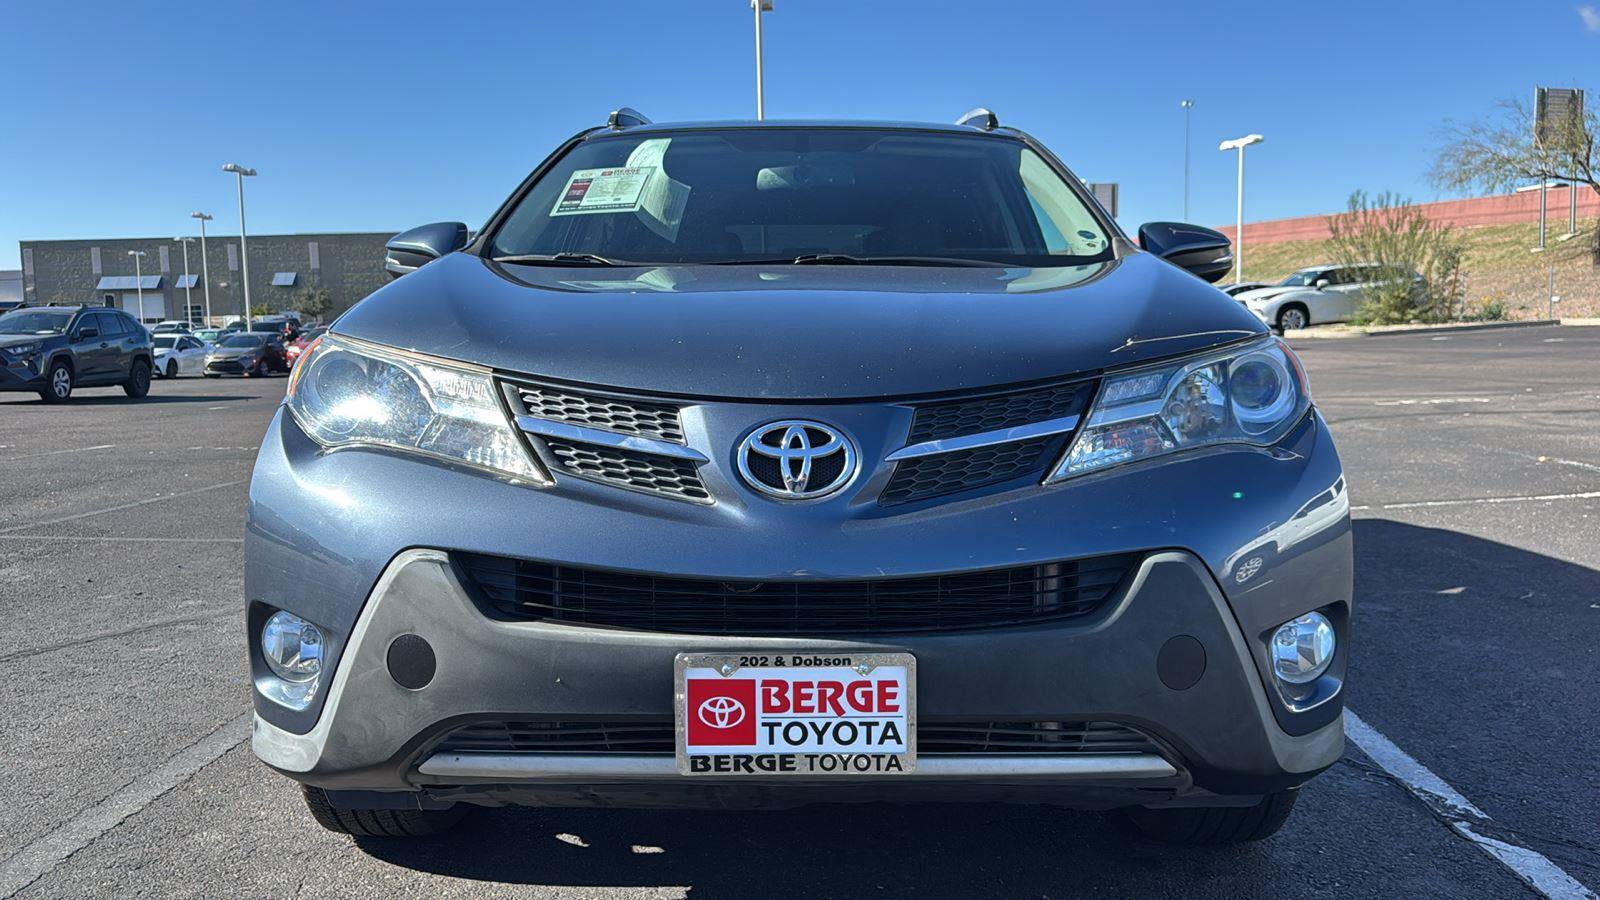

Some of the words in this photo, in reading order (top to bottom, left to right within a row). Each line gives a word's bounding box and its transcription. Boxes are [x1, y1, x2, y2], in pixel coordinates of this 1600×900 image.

[740, 656, 769, 667] 202
[774, 656, 787, 667] &
[792, 656, 852, 667] Dobson
[760, 679, 900, 717] BERGE
[761, 721, 903, 746] TOYOTA
[690, 754, 797, 773] BERGE
[804, 754, 903, 772] TOYOTA
